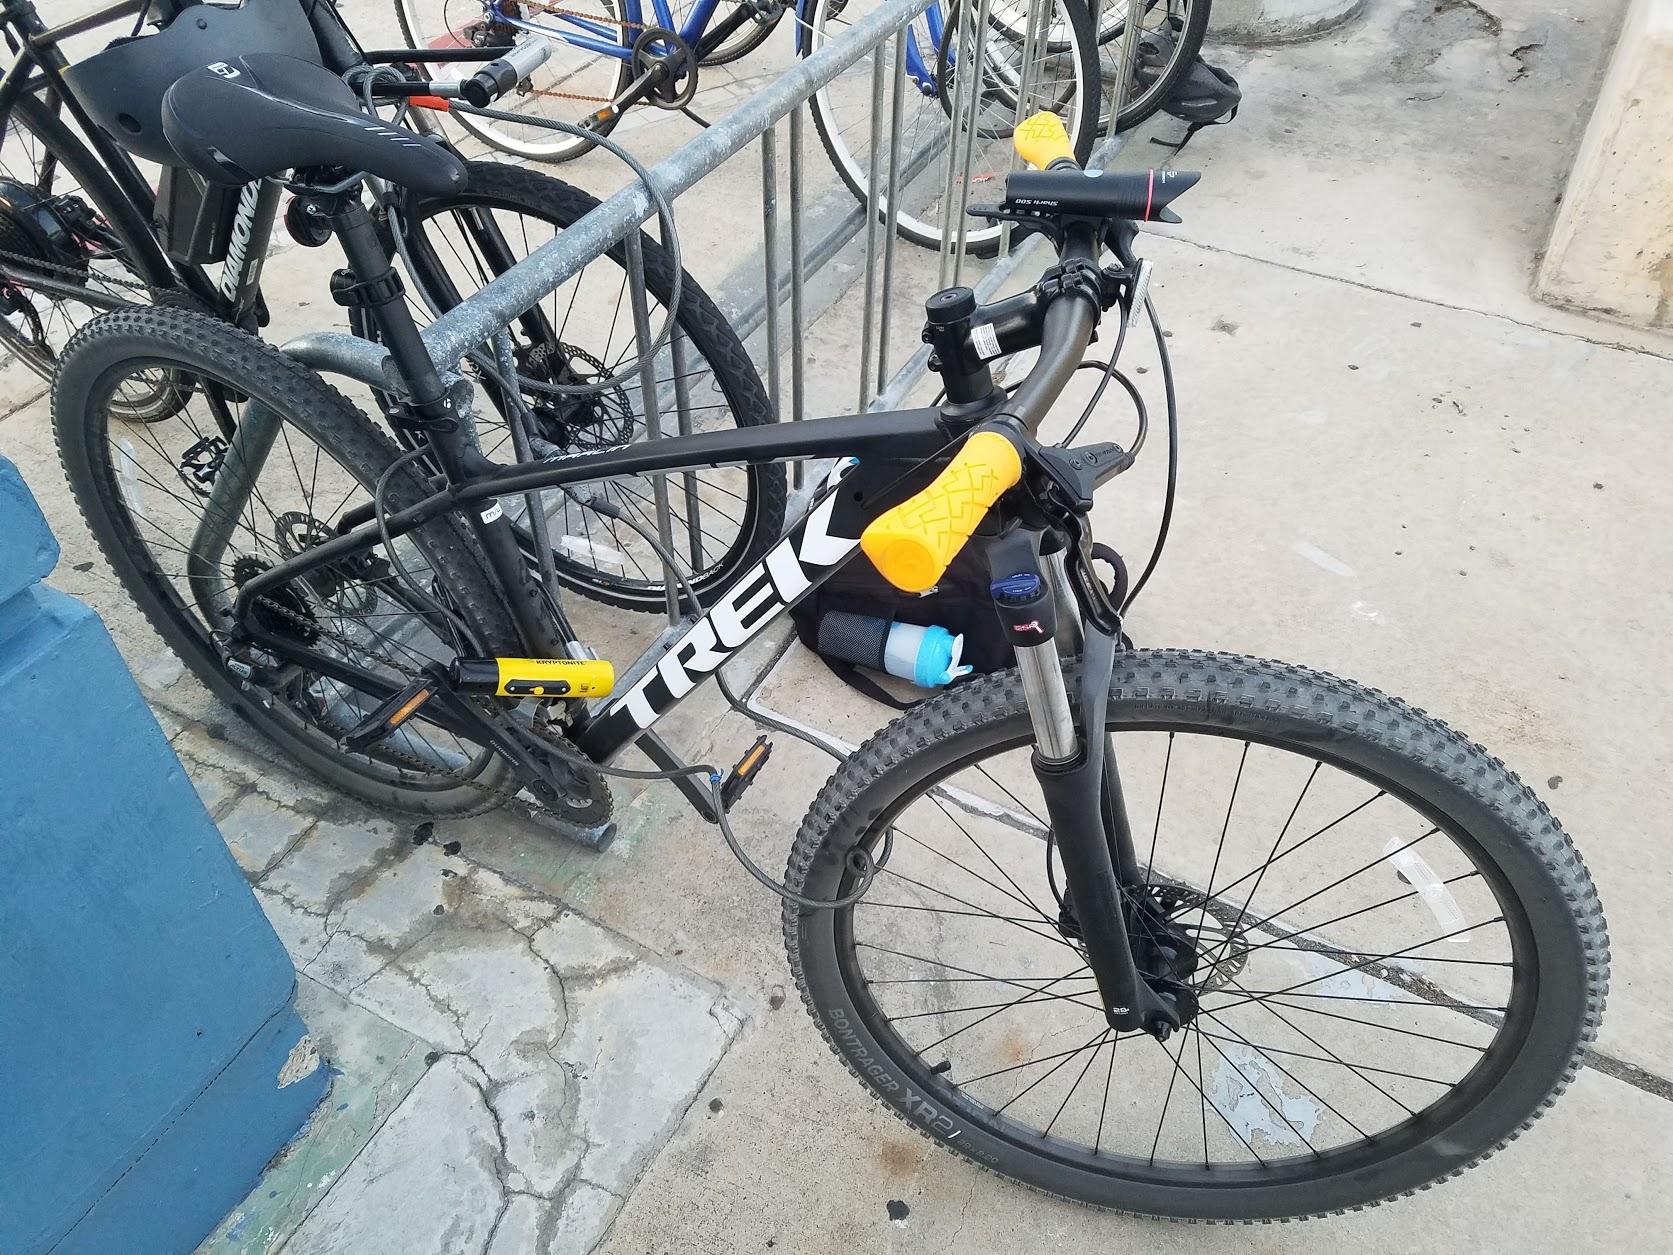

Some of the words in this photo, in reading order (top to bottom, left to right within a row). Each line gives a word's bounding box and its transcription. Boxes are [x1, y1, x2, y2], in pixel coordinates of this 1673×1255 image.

[220, 178, 262, 303] DIAMOND
[609, 487, 861, 729] TREK
[647, 560, 724, 591] DIANDBACK
[828, 1007, 900, 1093] BONTRAGER
[898, 1087, 953, 1132] XR2
